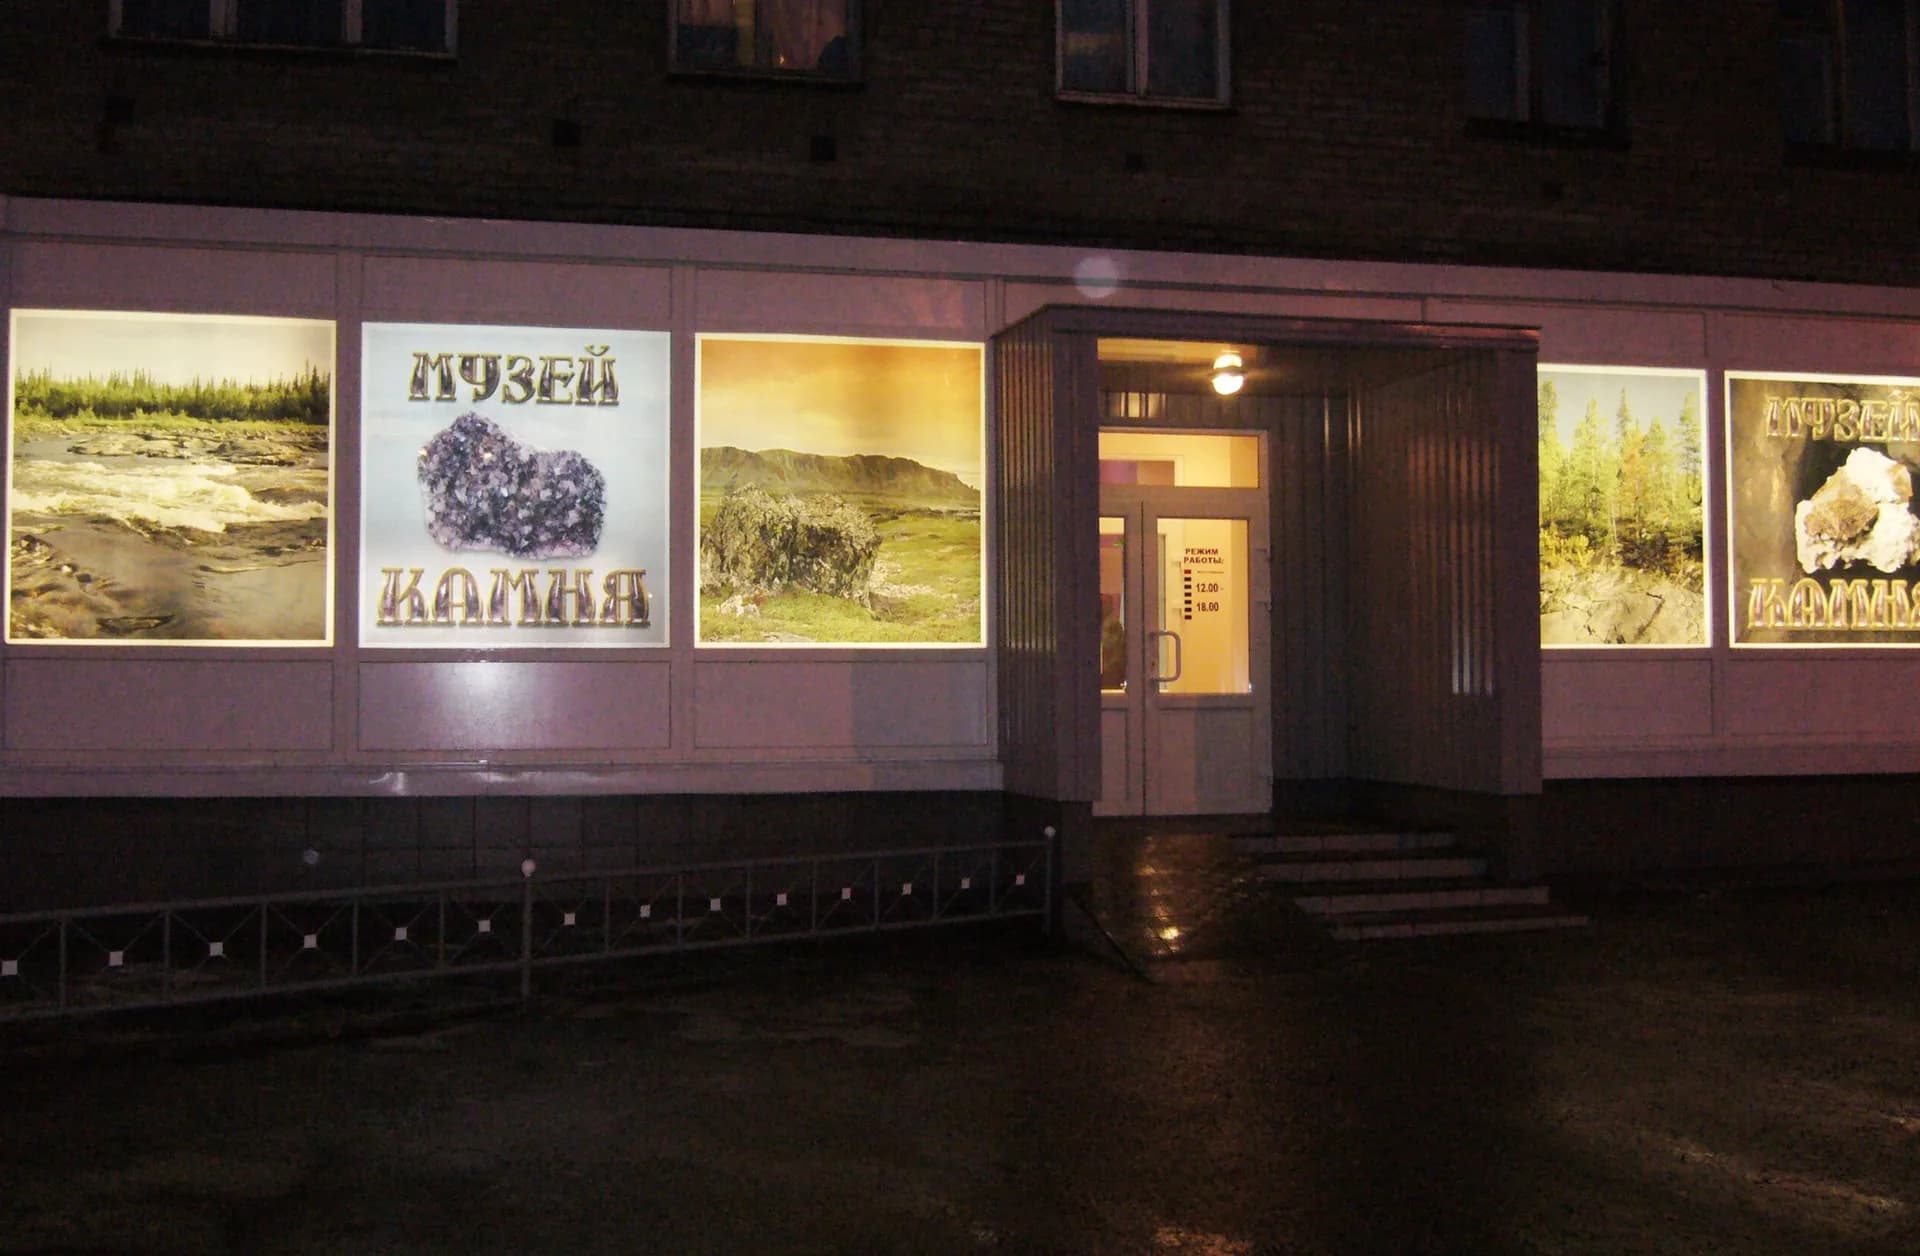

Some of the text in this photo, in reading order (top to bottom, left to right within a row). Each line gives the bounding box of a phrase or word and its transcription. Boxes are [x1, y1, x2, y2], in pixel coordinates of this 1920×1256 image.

[408, 344, 620, 406] МУЗЕЙ
[376, 567, 651, 627] КАМНЯ
[1196, 602, 1219, 612] 18.00
[1748, 577, 1920, 631] КАМН
